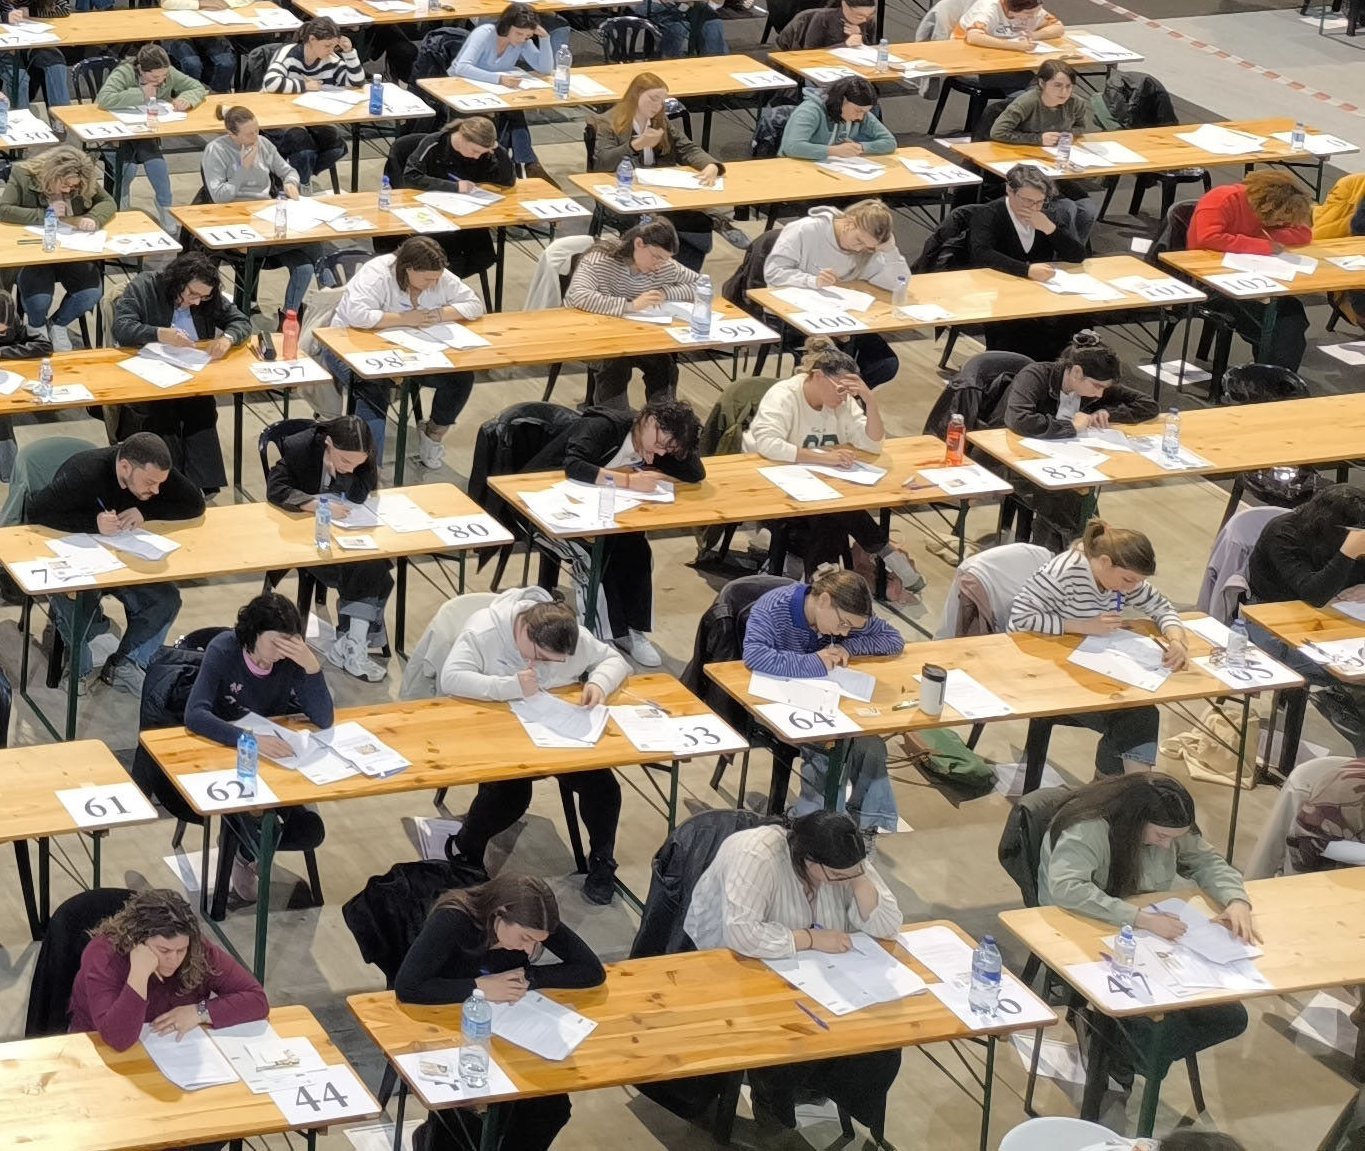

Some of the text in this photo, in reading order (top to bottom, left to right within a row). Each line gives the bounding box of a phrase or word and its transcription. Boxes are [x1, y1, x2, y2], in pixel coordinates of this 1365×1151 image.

[458, 96, 502, 107] 133
[9, 131, 50, 142] 130
[86, 125, 125, 141] 131
[533, 203, 582, 216] 116
[209, 229, 257, 242] 115
[1145, 284, 1193, 297] 101
[1221, 277, 1278, 291] 102
[805, 315, 857, 330] 100
[719, 325, 756, 338] 99
[271, 365, 306, 380] 97
[365, 359, 404, 371] 98
[1041, 464, 1087, 481] 83
[446, 522, 490, 540] 80
[788, 711, 838, 732] 64
[205, 779, 256, 803] 62
[83, 795, 133, 819] 61
[295, 1081, 351, 1112] 44
